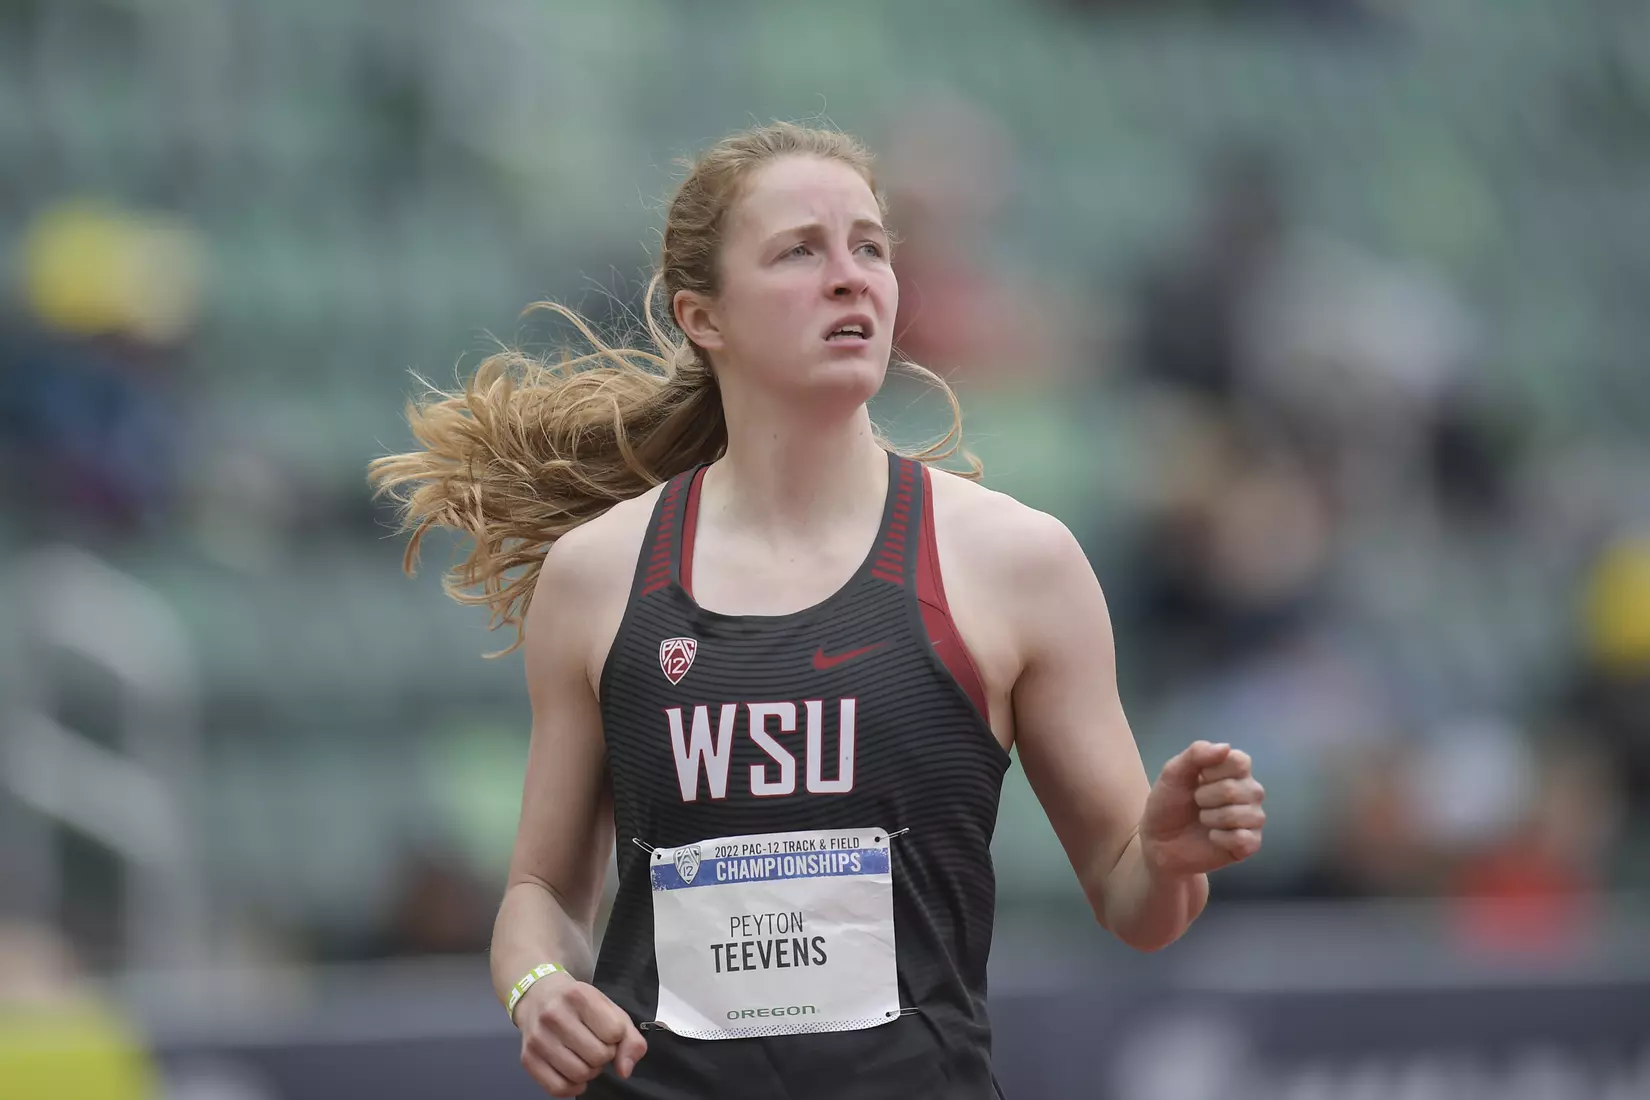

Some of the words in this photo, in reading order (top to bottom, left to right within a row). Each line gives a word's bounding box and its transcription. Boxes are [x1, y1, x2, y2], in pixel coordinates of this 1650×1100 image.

[662, 640, 695, 666] PAC
[668, 657, 686, 674] 12
[661, 697, 858, 802] WSU
[715, 844, 739, 858] 2022
[742, 842, 780, 856] PAC-12
[783, 839, 817, 854] TRACK
[819, 838, 827, 850] &
[830, 837, 860, 850] FIELD
[683, 865, 694, 877] 12
[716, 852, 861, 882] CHAMPIONSHIPS
[729, 911, 804, 938] PEYTON
[710, 935, 828, 973] TEEVENS
[726, 1005, 816, 1020] OREGON
